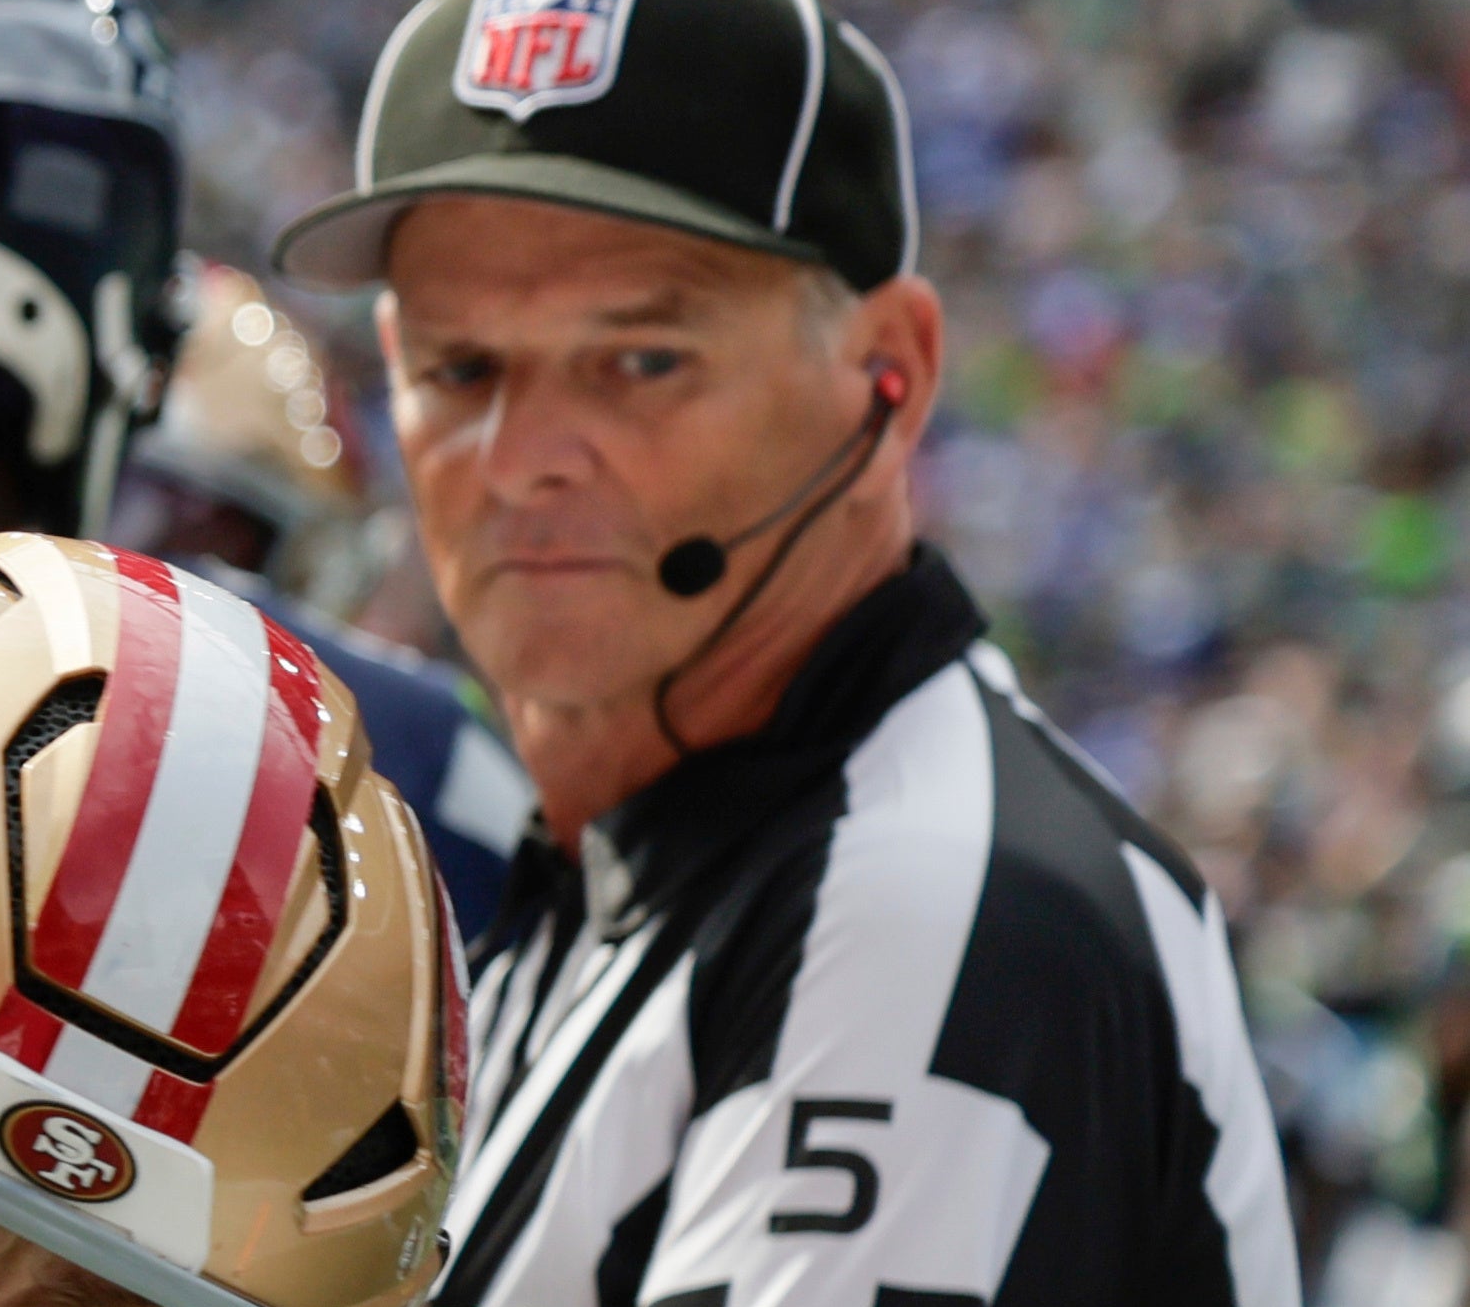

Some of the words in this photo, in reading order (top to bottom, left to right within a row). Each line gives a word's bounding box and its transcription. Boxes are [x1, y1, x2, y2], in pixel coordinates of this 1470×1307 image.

[473, 8, 598, 90] NFL
[31, 1115, 118, 1191] SF
[768, 1099, 893, 1236] 5
